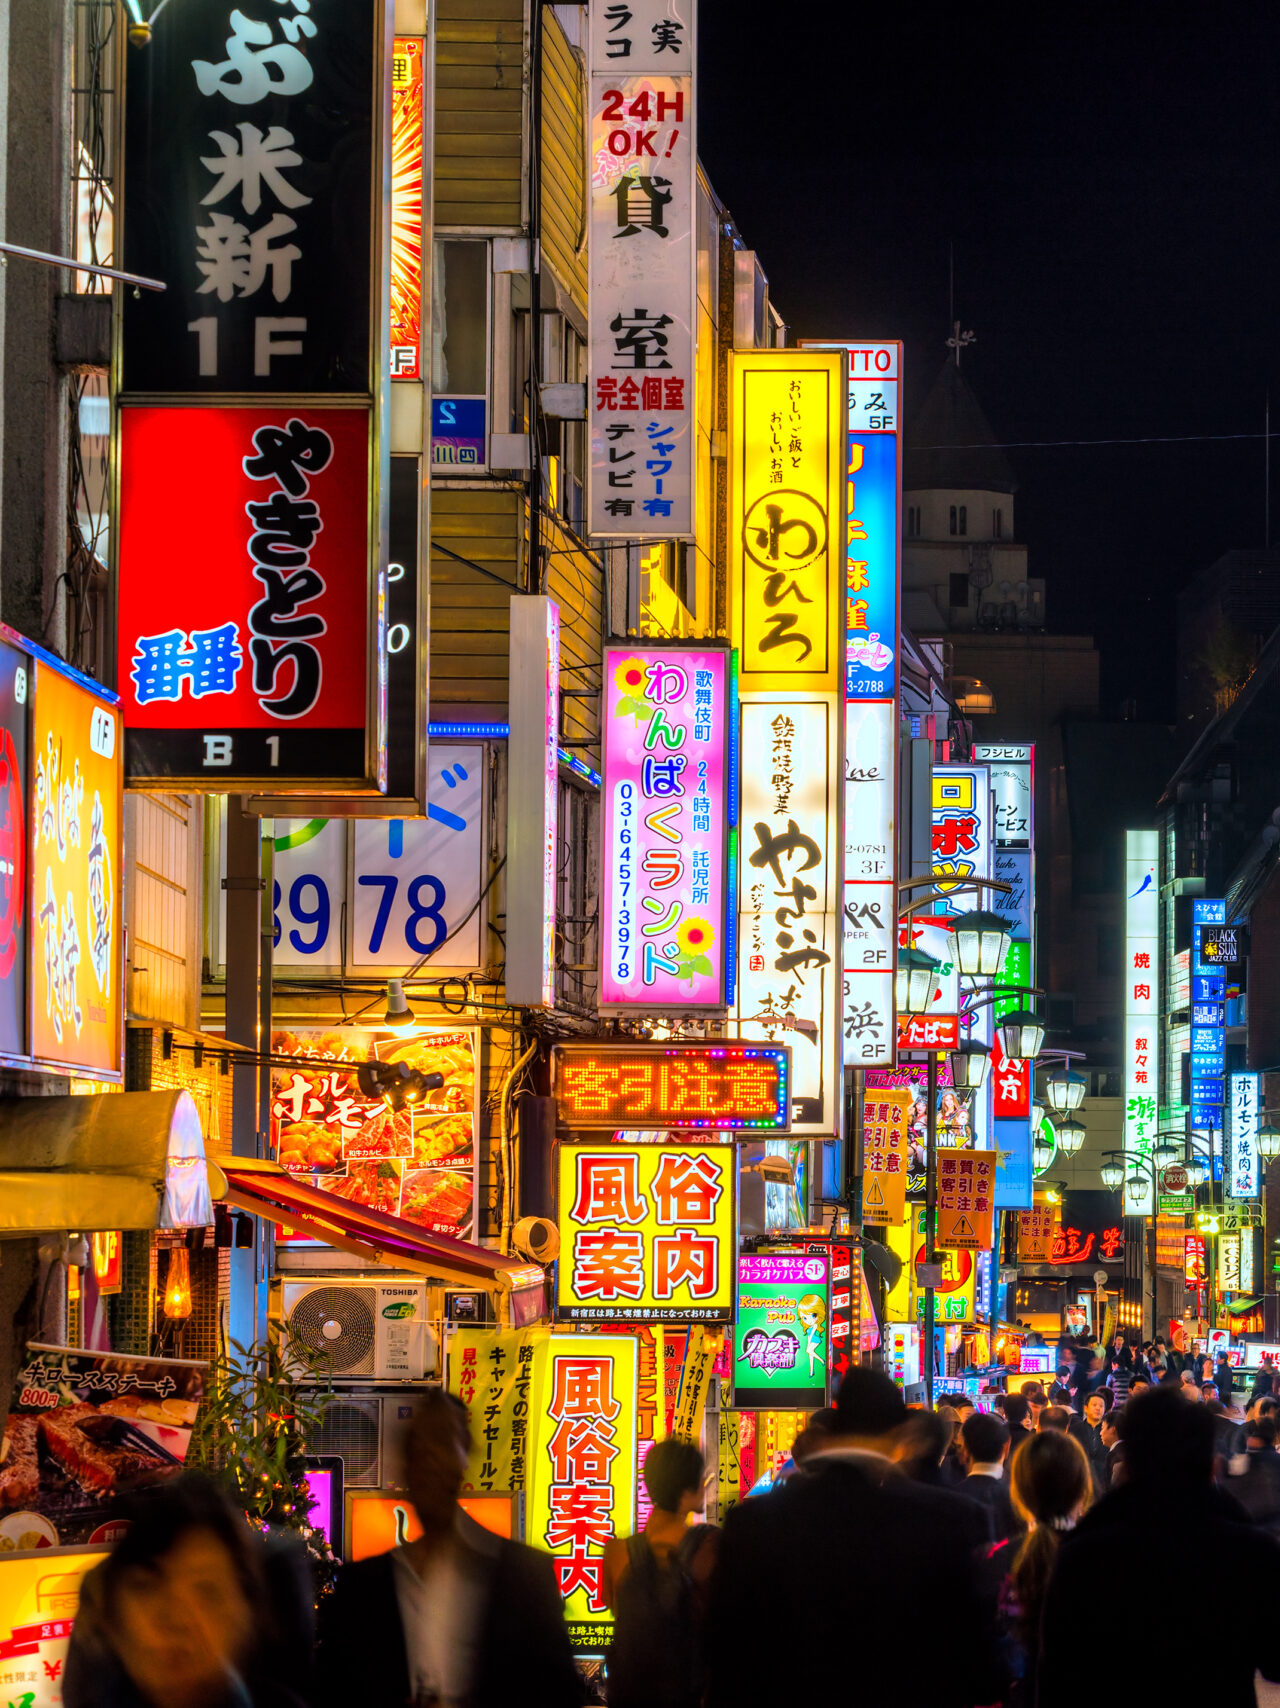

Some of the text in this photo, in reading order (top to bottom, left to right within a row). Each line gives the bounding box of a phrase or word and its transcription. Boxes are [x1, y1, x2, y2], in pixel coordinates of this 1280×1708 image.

[651, 20, 684, 54] 実
[601, 90, 684, 122] 24H
[607, 130, 680, 158] OK!
[188, 316, 307, 377] 1F
[596, 376, 685, 411] 完全個室
[789, 380, 803, 468] おいしいご飯と
[869, 416, 893, 430] 5F
[770, 411, 784, 484] おいしいお酒
[604, 423, 635, 517] テレビ有
[643, 422, 675, 517] シャワー有
[243, 418, 334, 720] やきとり
[130, 622, 243, 705] 番番
[981, 748, 1025, 758] フジビル
[692, 670, 713, 905] 歌舞伎町 24時間 託児所
[641, 661, 688, 985] わんぱくランド
[617, 784, 633, 979] 03-6457-3978
[861, 859, 886, 875] 3F
[358, 874, 447, 955] 78
[1195, 903, 1219, 912] えびす
[1208, 929, 1238, 943] BLACK
[1218, 942, 1237, 956] SUN
[863, 950, 887, 964] 2F
[844, 1001, 884, 1039] 浜
[862, 1044, 886, 1058] 2F
[1135, 1038, 1149, 1084] 叙々苑
[564, 1060, 778, 1113] 客引注意
[868, 1075, 910, 1087] TANK
[864, 1103, 902, 1123] 悪質な
[1236, 1077, 1253, 1172] ホルモン焼肉
[941, 1159, 990, 1175] 悪質な
[570, 1153, 724, 1225] 風俗
[941, 1177, 989, 1193] 客引き
[940, 1196, 988, 1212] に注意
[1021, 1216, 1051, 1226] 客引き
[1021, 1227, 1052, 1237] に注意
[571, 1228, 719, 1300] 案内
[805, 1263, 823, 1276] 5F
[739, 1296, 797, 1309] Karaoke
[766, 1311, 796, 1324] Pub
[24, 1362, 176, 1397] 牛ロースステーキ
[19, 1388, 58, 1407] 800円
[546, 1355, 621, 1614] 風俗案内
